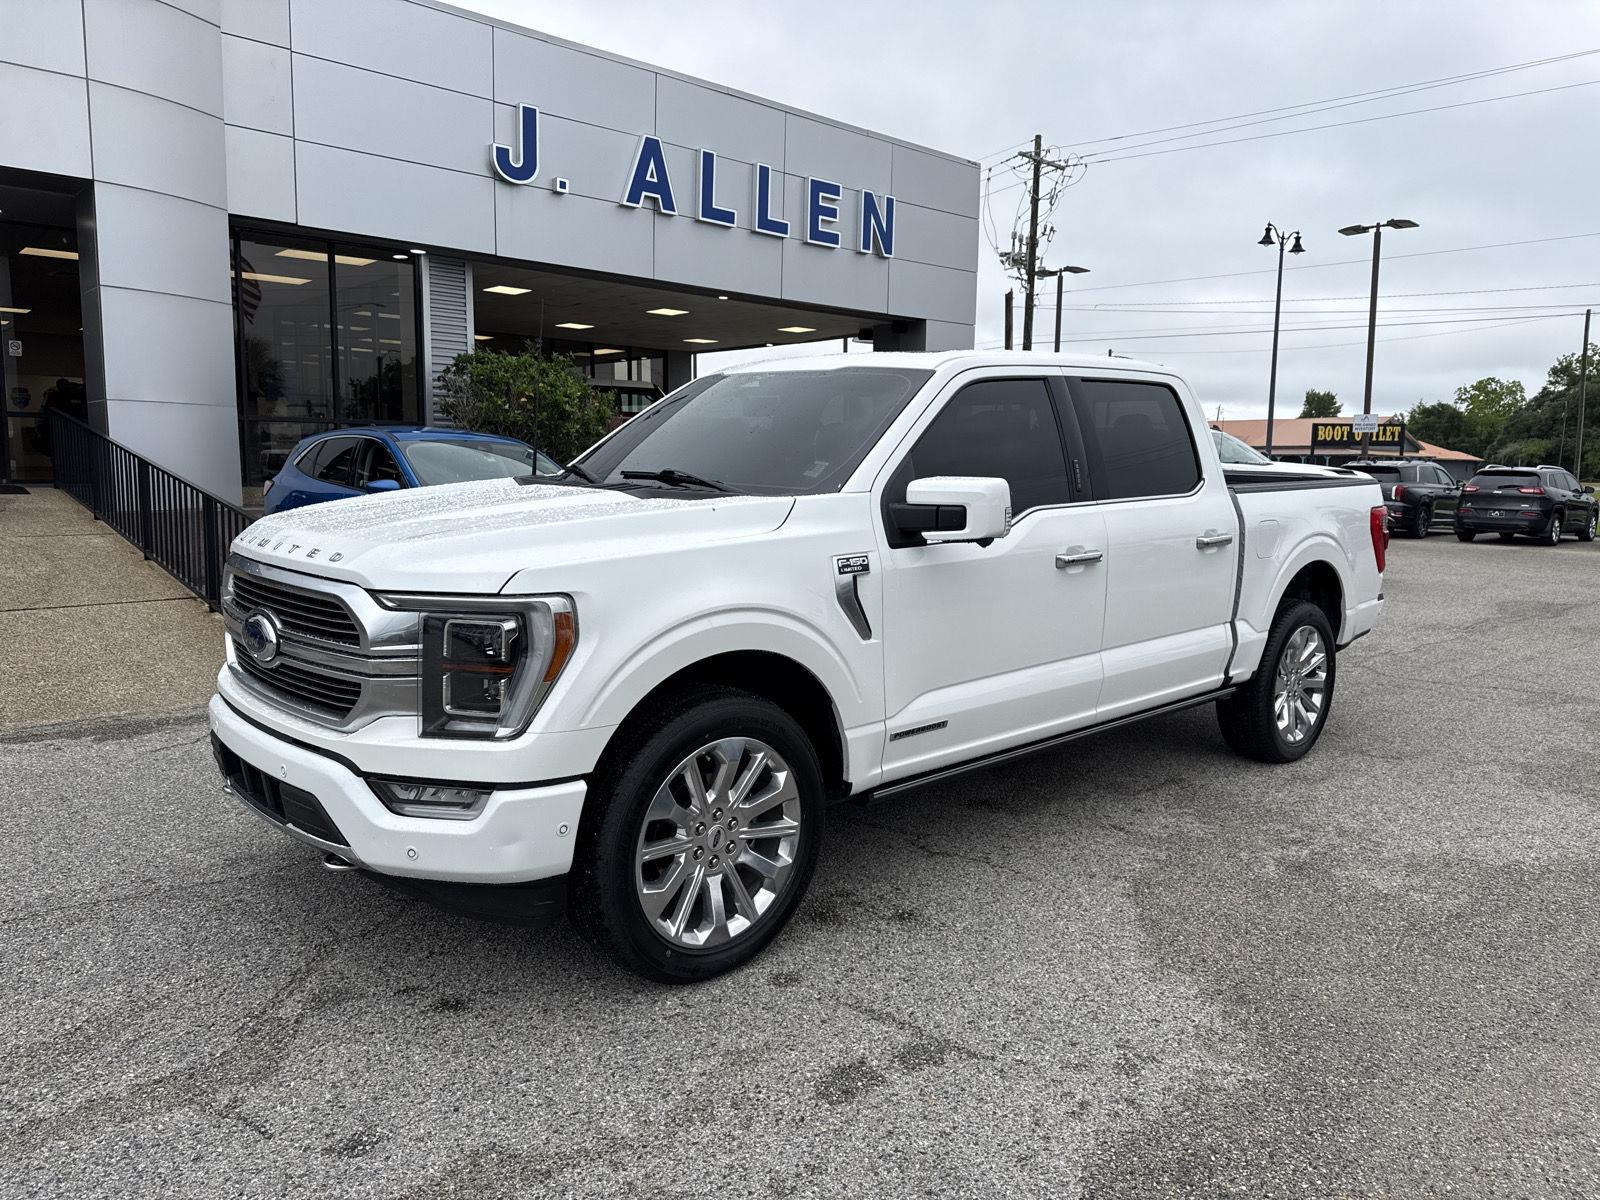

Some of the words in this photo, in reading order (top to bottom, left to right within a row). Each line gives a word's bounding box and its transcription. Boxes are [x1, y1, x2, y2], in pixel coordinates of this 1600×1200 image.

[489, 102, 570, 195] J.
[619, 134, 896, 258] ALLEN
[1317, 425, 1350, 441] BOOT
[1354, 426, 1401, 441] OTLET
[240, 532, 345, 563] LIMITED
[838, 557, 868, 567] F-150
